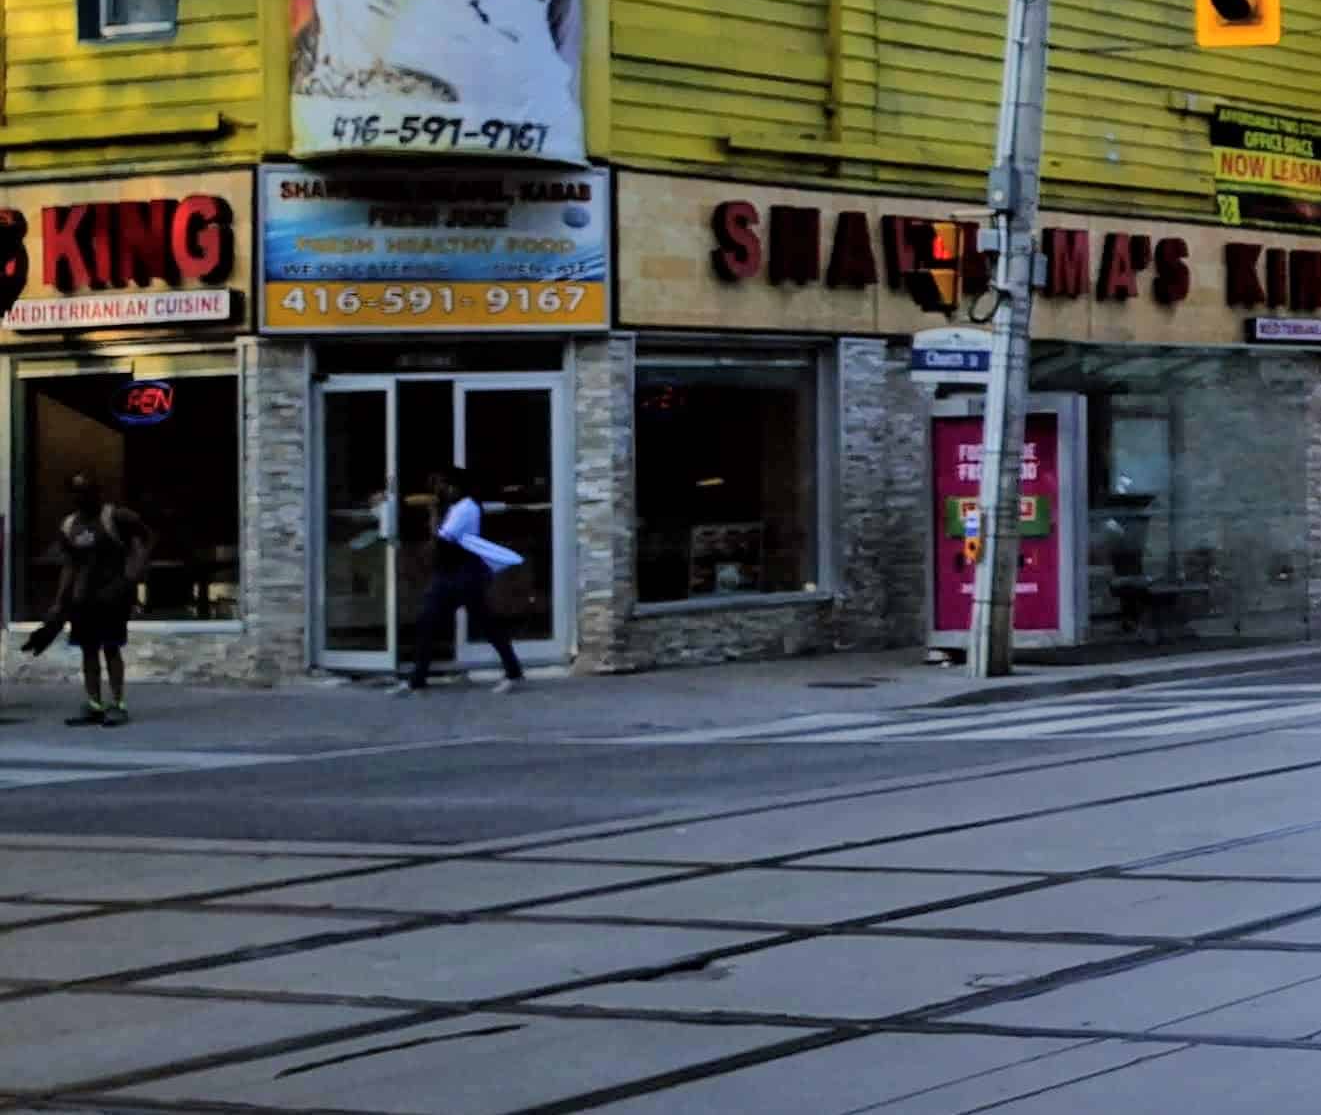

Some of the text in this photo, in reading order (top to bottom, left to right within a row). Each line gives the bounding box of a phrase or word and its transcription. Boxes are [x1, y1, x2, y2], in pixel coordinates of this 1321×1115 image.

[1221, 152, 1265, 179] NOW
[41, 194, 231, 293] KING
[711, 200, 1191, 306] SHAMA'S
[6, 292, 223, 324] MEDITERRANEAN CUISINE
